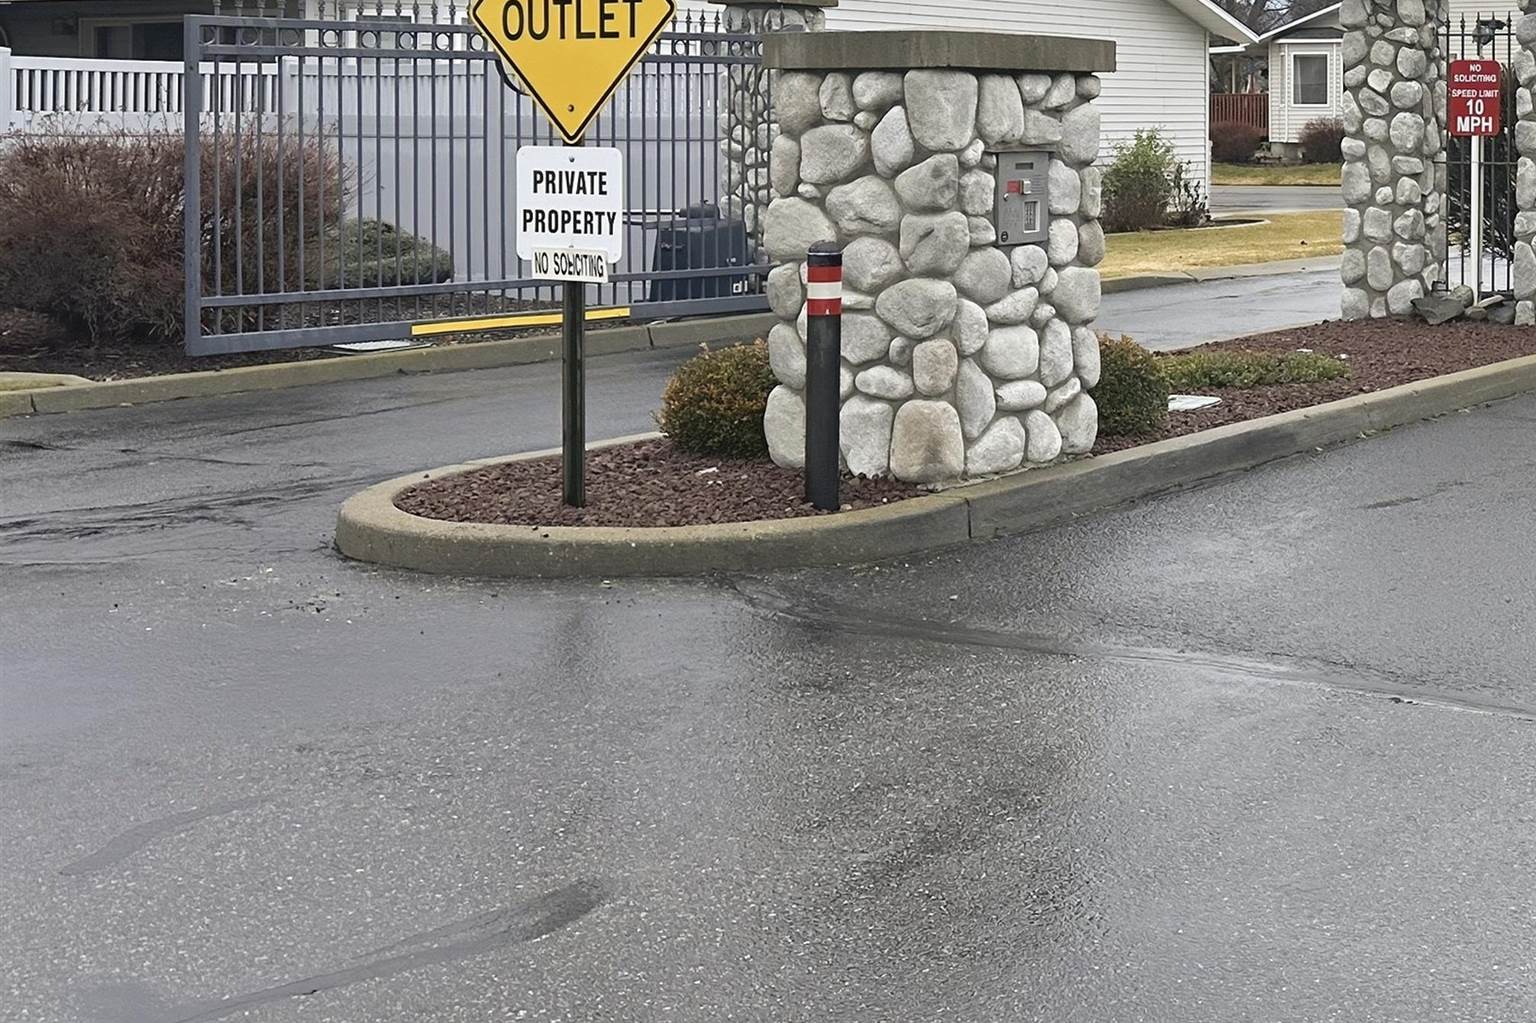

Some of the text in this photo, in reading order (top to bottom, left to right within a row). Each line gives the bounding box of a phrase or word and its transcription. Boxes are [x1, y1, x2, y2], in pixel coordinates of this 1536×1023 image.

[1470, 64, 1481, 72] NO
[1454, 74, 1496, 82] SOLICITING
[1452, 89, 1499, 98] SPEED LIMIT
[1466, 99, 1484, 115] 10
[1457, 116, 1492, 132] MPH
[533, 170, 607, 195] PRIVATE
[523, 209, 617, 235] PROPERTY
[534, 252, 548, 274] NO
